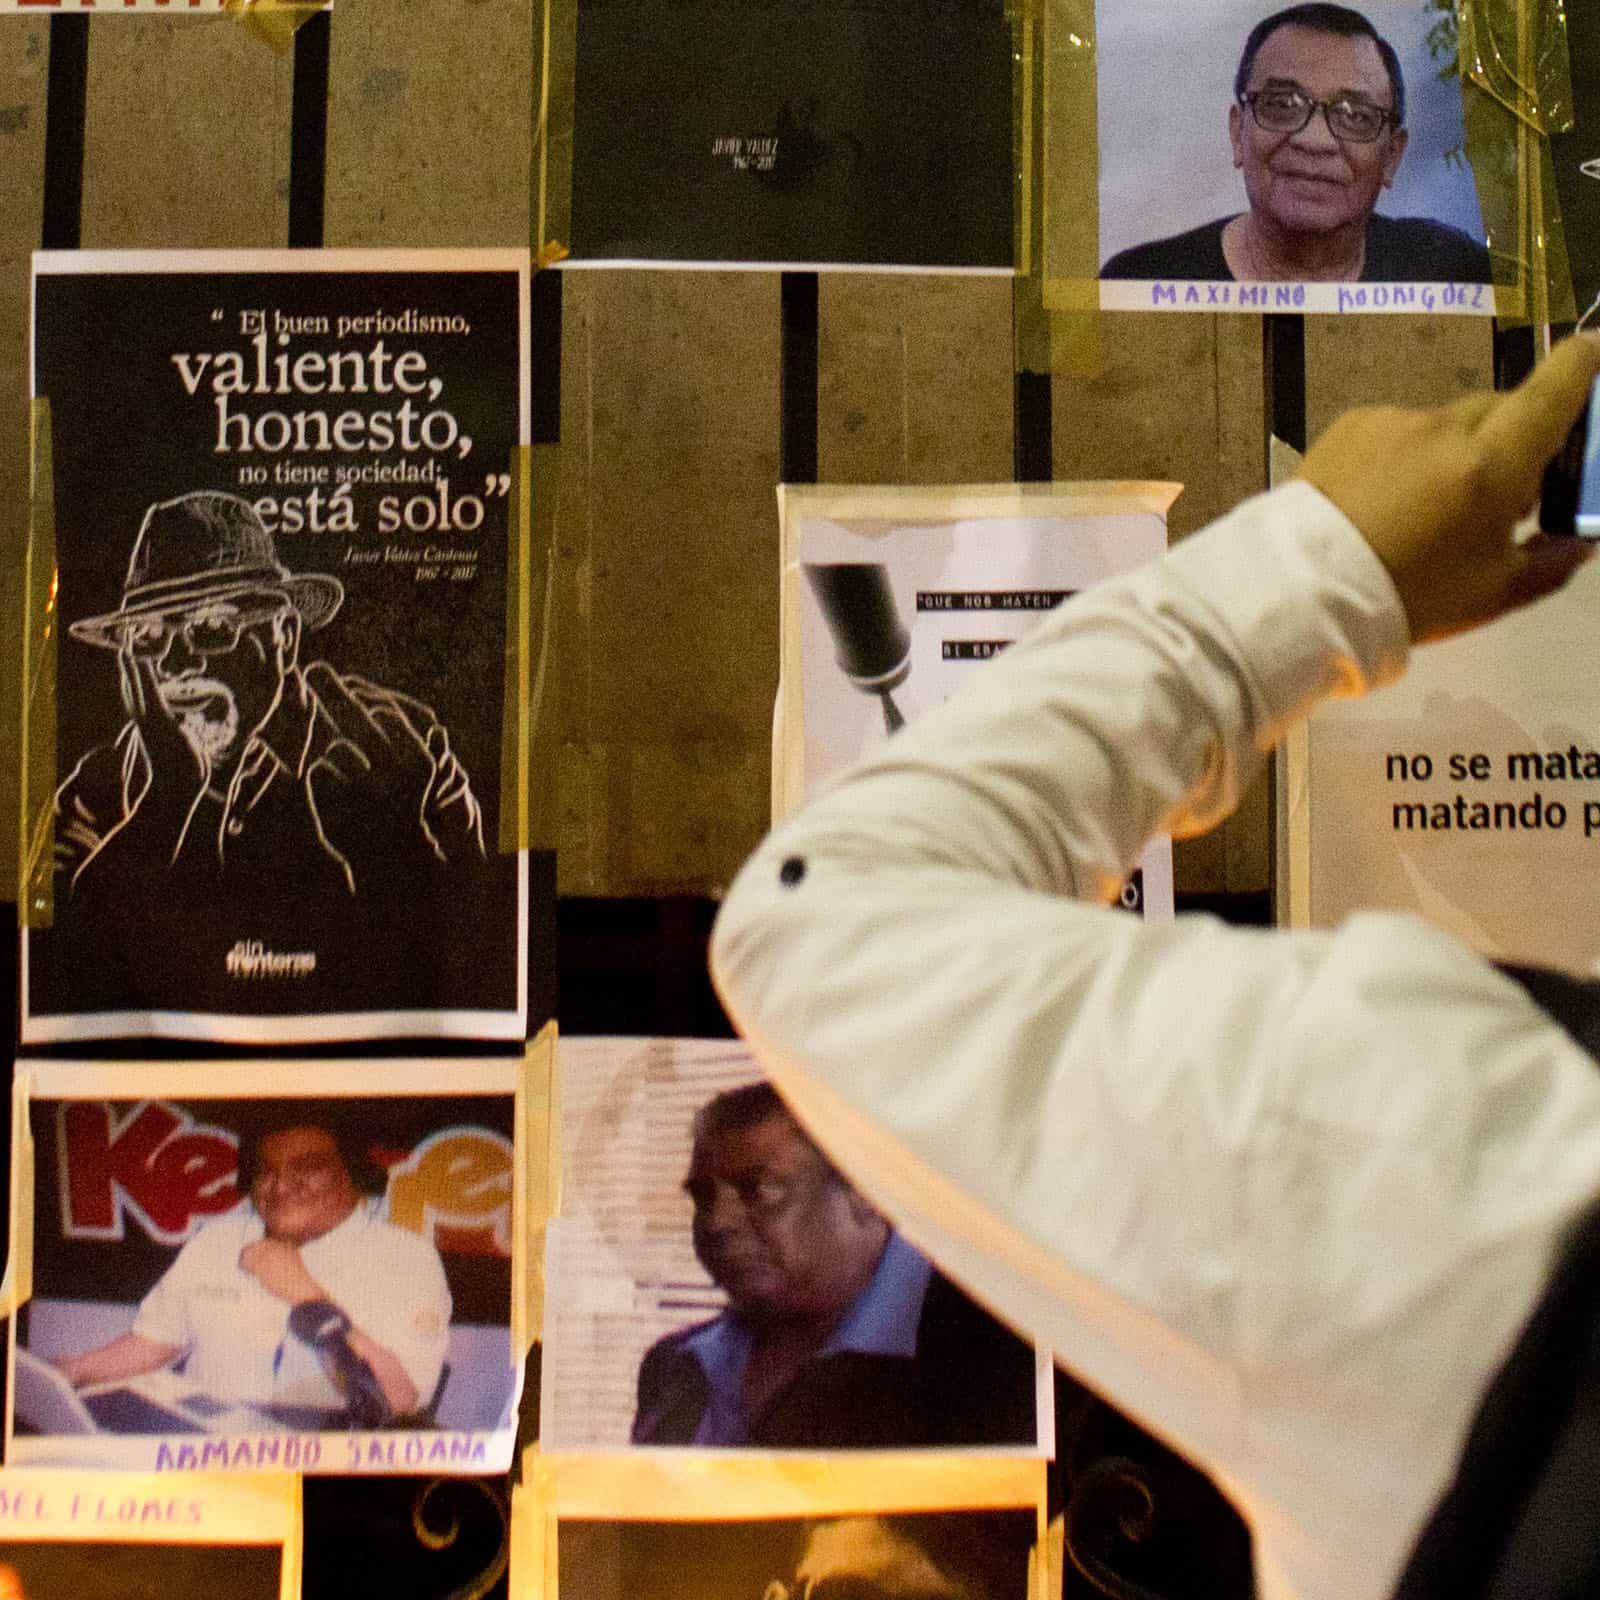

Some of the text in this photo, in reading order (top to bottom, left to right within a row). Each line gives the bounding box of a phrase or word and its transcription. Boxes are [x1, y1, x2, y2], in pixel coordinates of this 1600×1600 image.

[1151, 282, 1306, 308] MAXIMINO
[274, 309, 471, 339] buen periodismo,
[171, 334, 443, 401] valiente,
[214, 393, 473, 459] honesto,
[252, 482, 360, 534] está
[1386, 753, 1434, 782] no
[1449, 752, 1492, 781] se
[1392, 794, 1567, 830] matando
[156, 1437, 321, 1474] ARMANDO
[70, 1497, 203, 1527] FLORES
